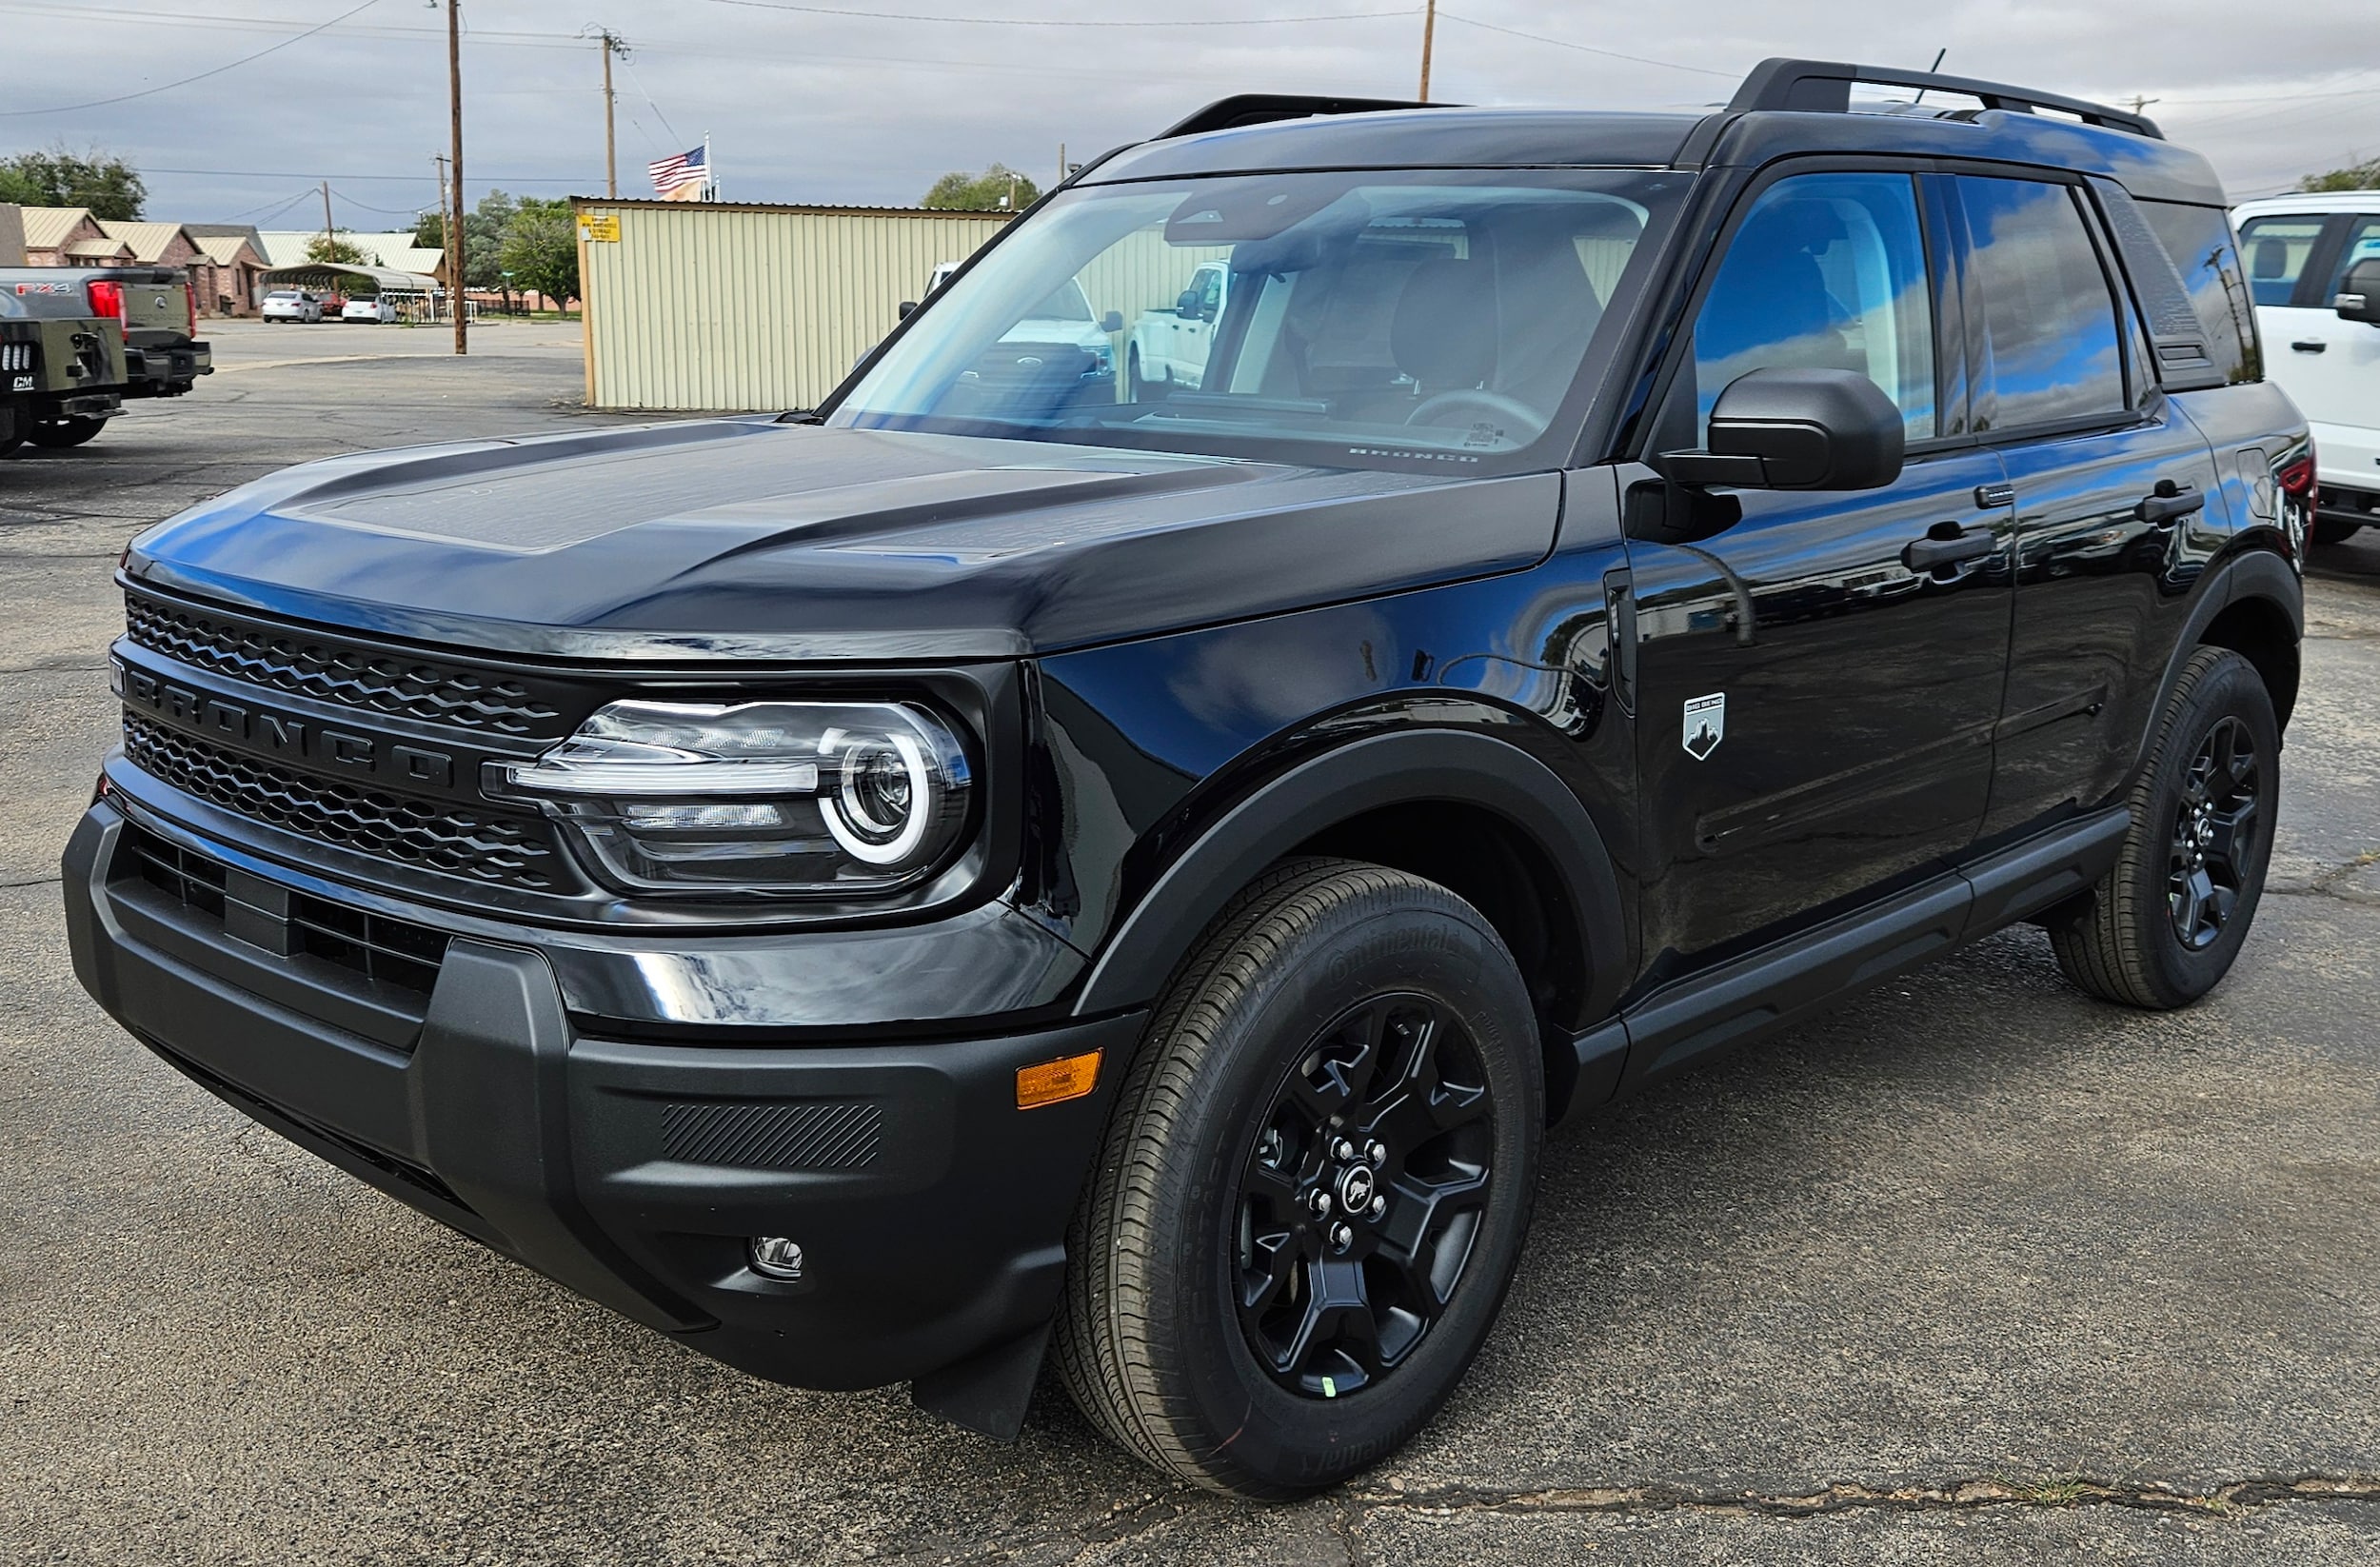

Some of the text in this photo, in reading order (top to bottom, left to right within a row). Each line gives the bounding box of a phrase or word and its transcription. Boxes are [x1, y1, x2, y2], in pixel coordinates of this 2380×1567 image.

[16, 283, 73, 297] FX4
[13, 376, 33, 388] CM
[1348, 447, 1478, 463] BRONCO
[1686, 698, 1722, 711] BIG BEND
[129, 670, 453, 788] BRONCO
